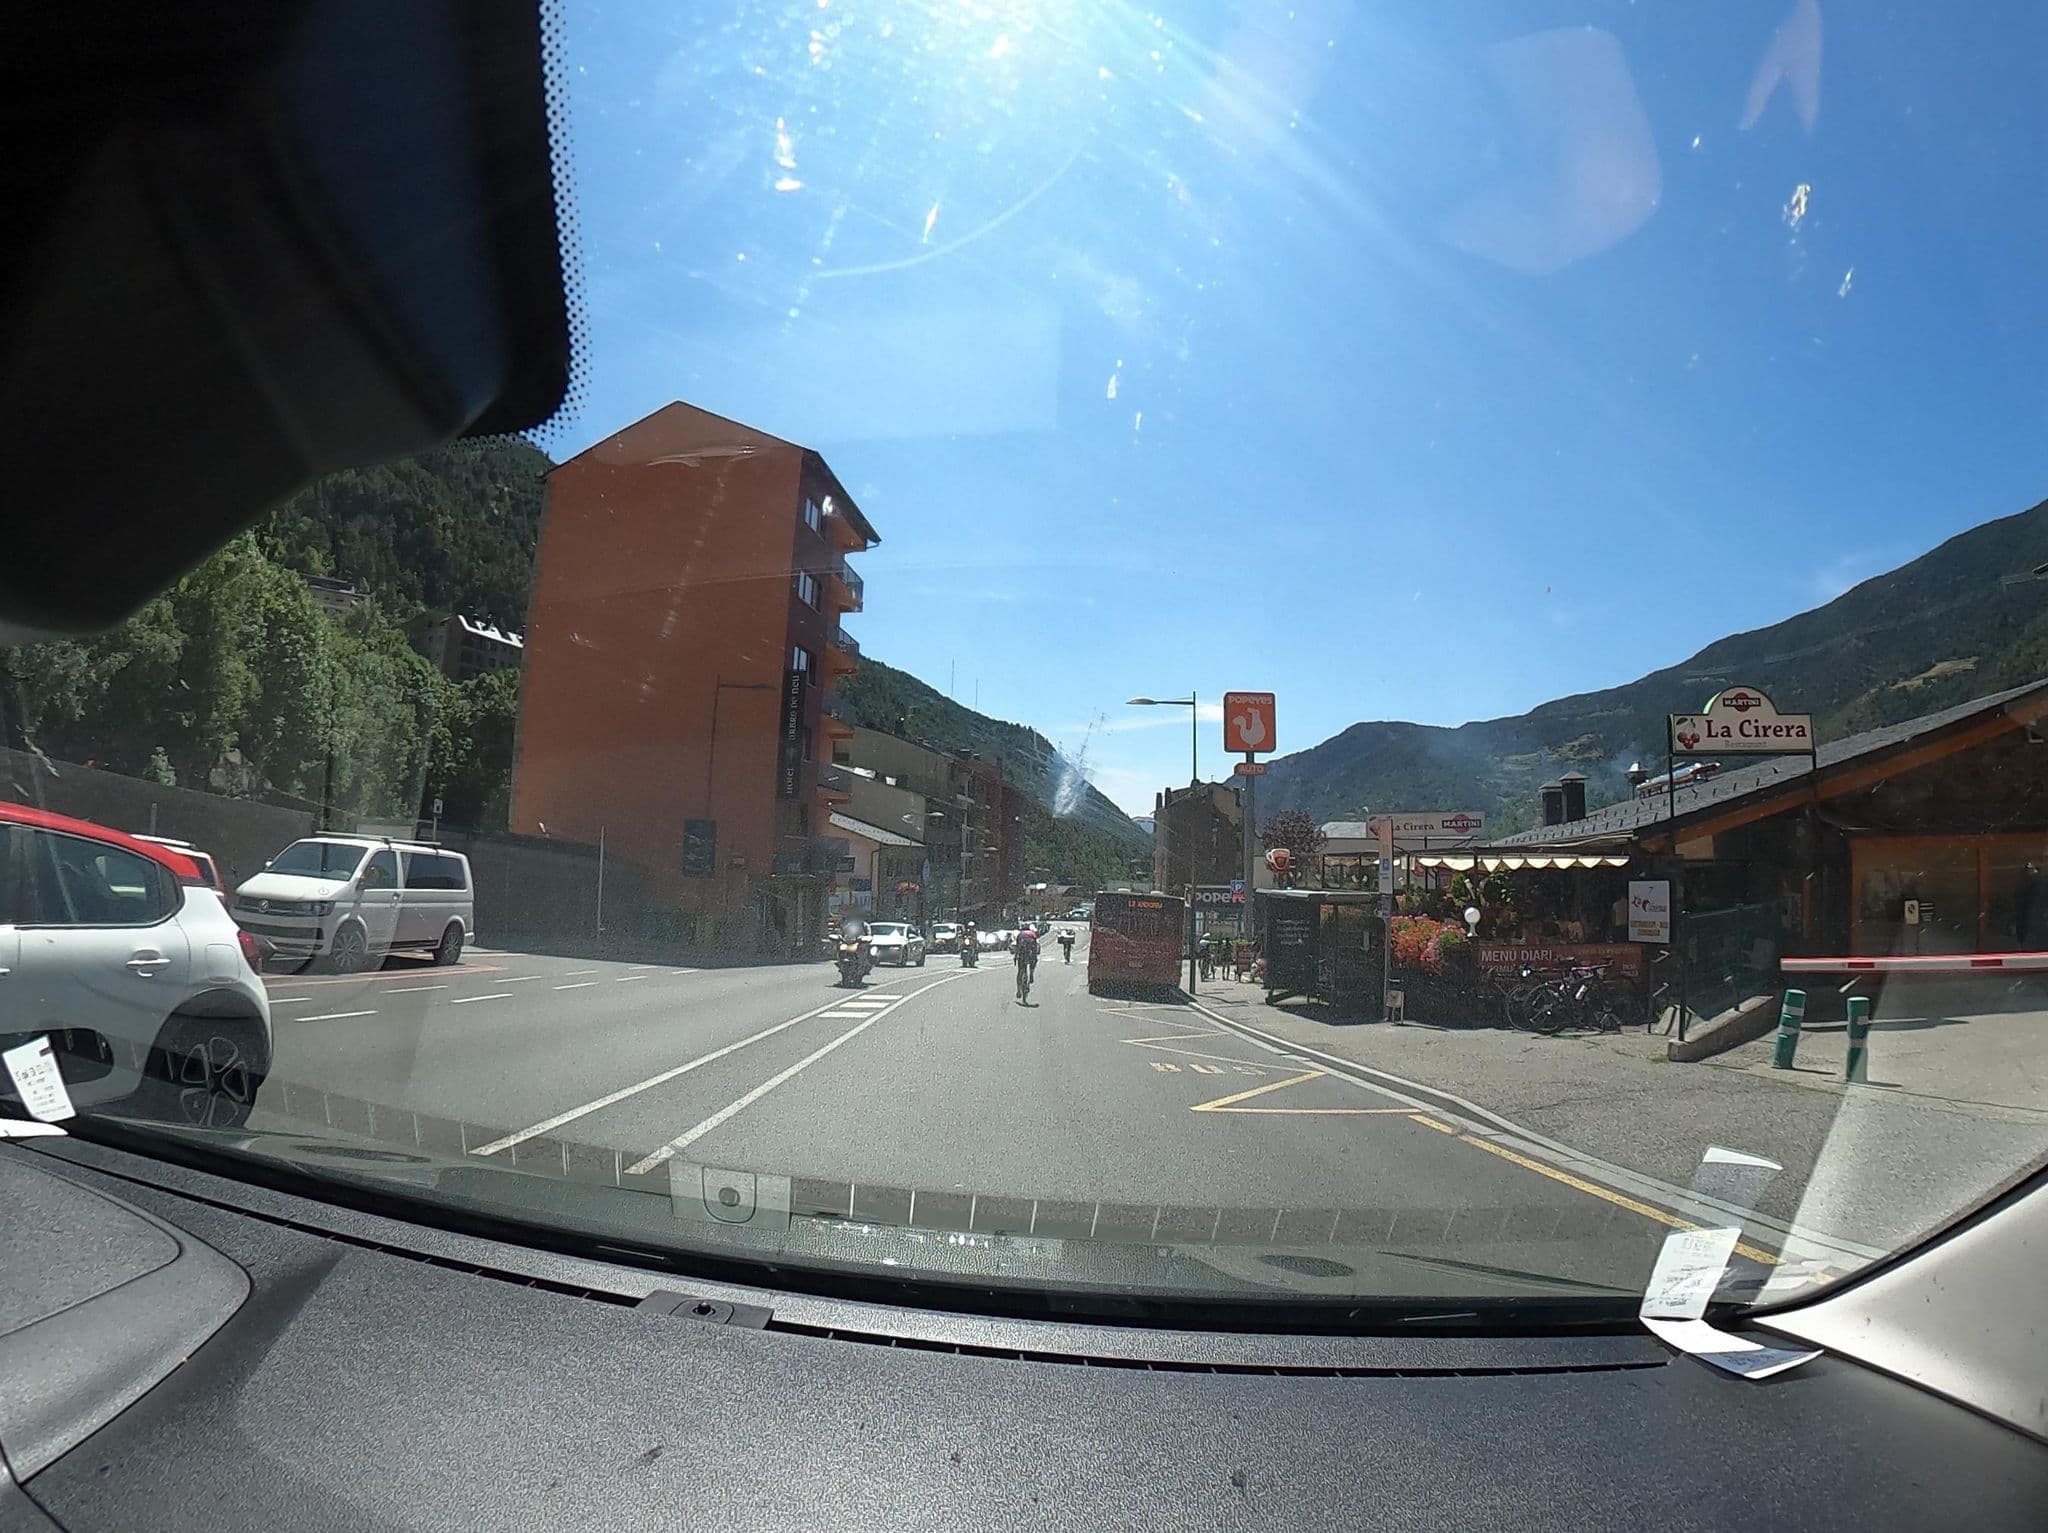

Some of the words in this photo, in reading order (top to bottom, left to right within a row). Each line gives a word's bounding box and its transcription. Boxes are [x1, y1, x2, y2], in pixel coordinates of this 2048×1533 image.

[1705, 719, 1733, 738] La
[1738, 719, 1808, 738] Cirera
[1403, 822, 1435, 831] Cirera
[1443, 820, 1480, 828] MARTINI
[1481, 950, 1517, 962] MENU
